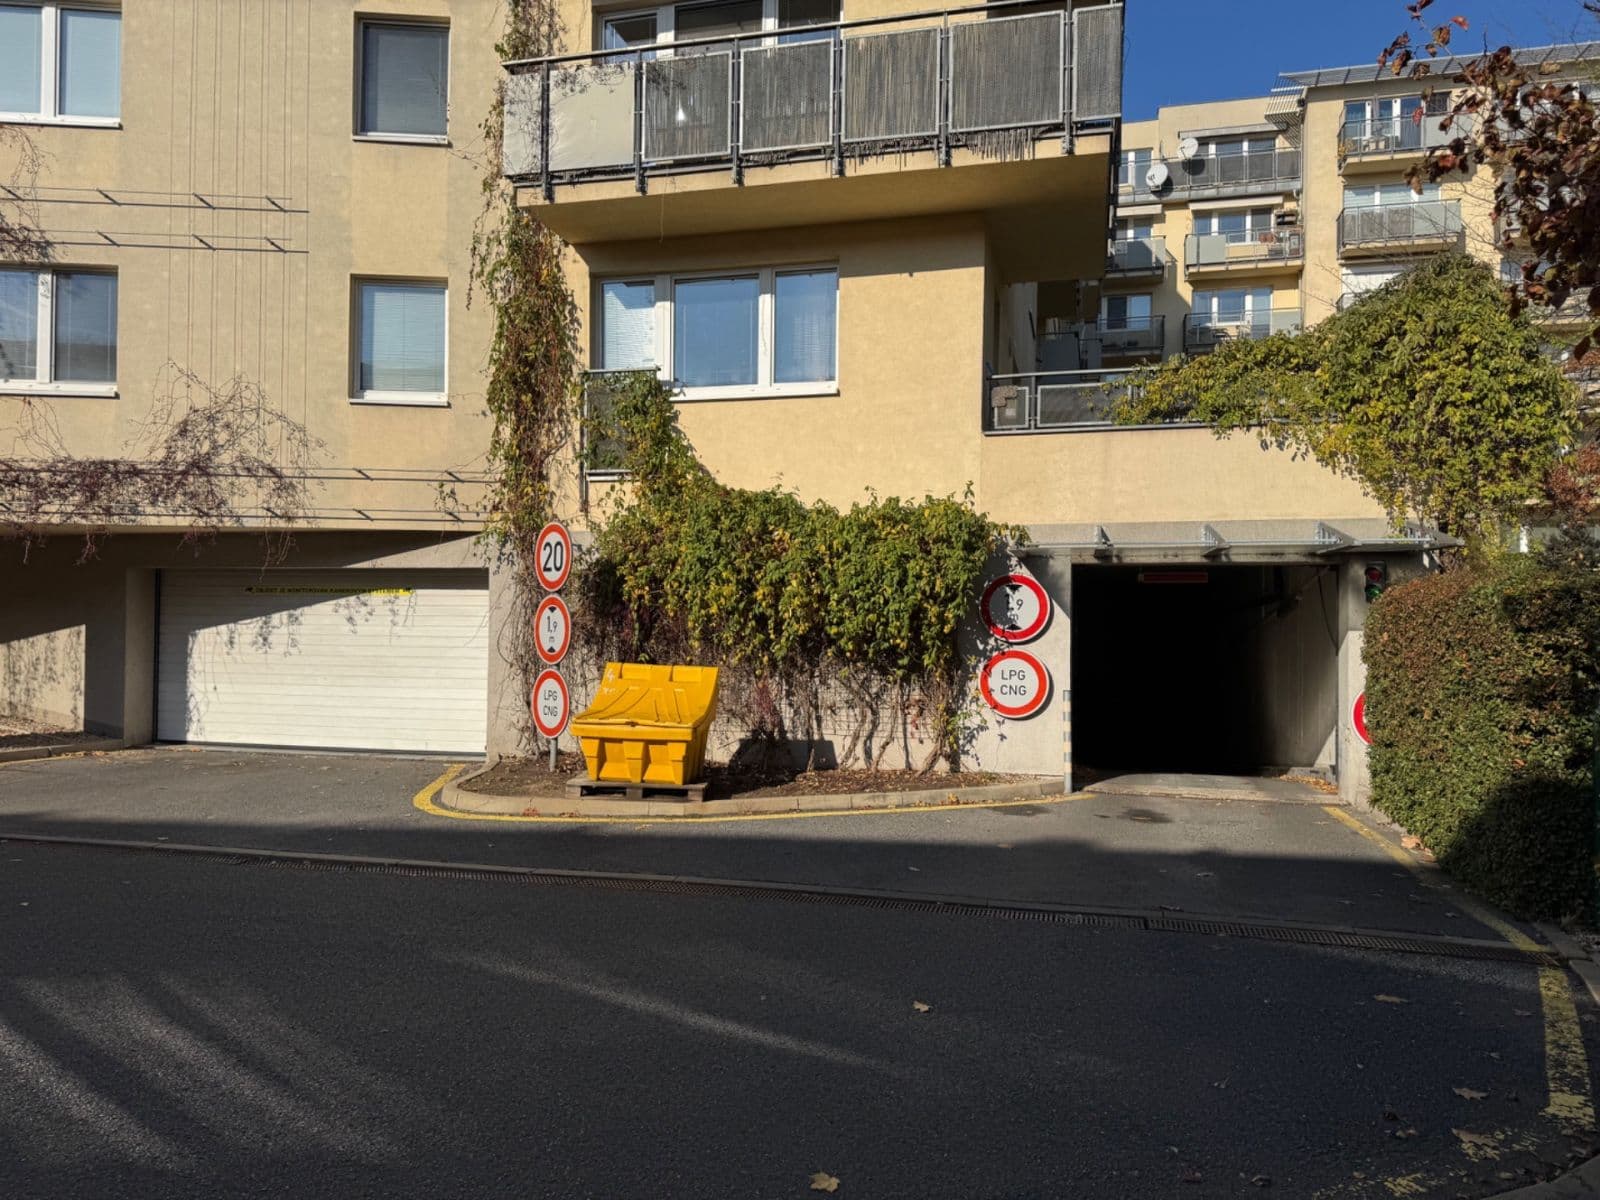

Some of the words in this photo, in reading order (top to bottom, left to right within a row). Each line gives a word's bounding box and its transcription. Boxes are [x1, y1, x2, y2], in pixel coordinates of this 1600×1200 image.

[543, 541, 563, 572] 20
[547, 615, 558, 633] 1,9
[1001, 669, 1026, 681] LPG
[543, 689, 558, 702] LPG
[1000, 684, 1027, 696] CNG
[543, 705, 558, 717] CNG
